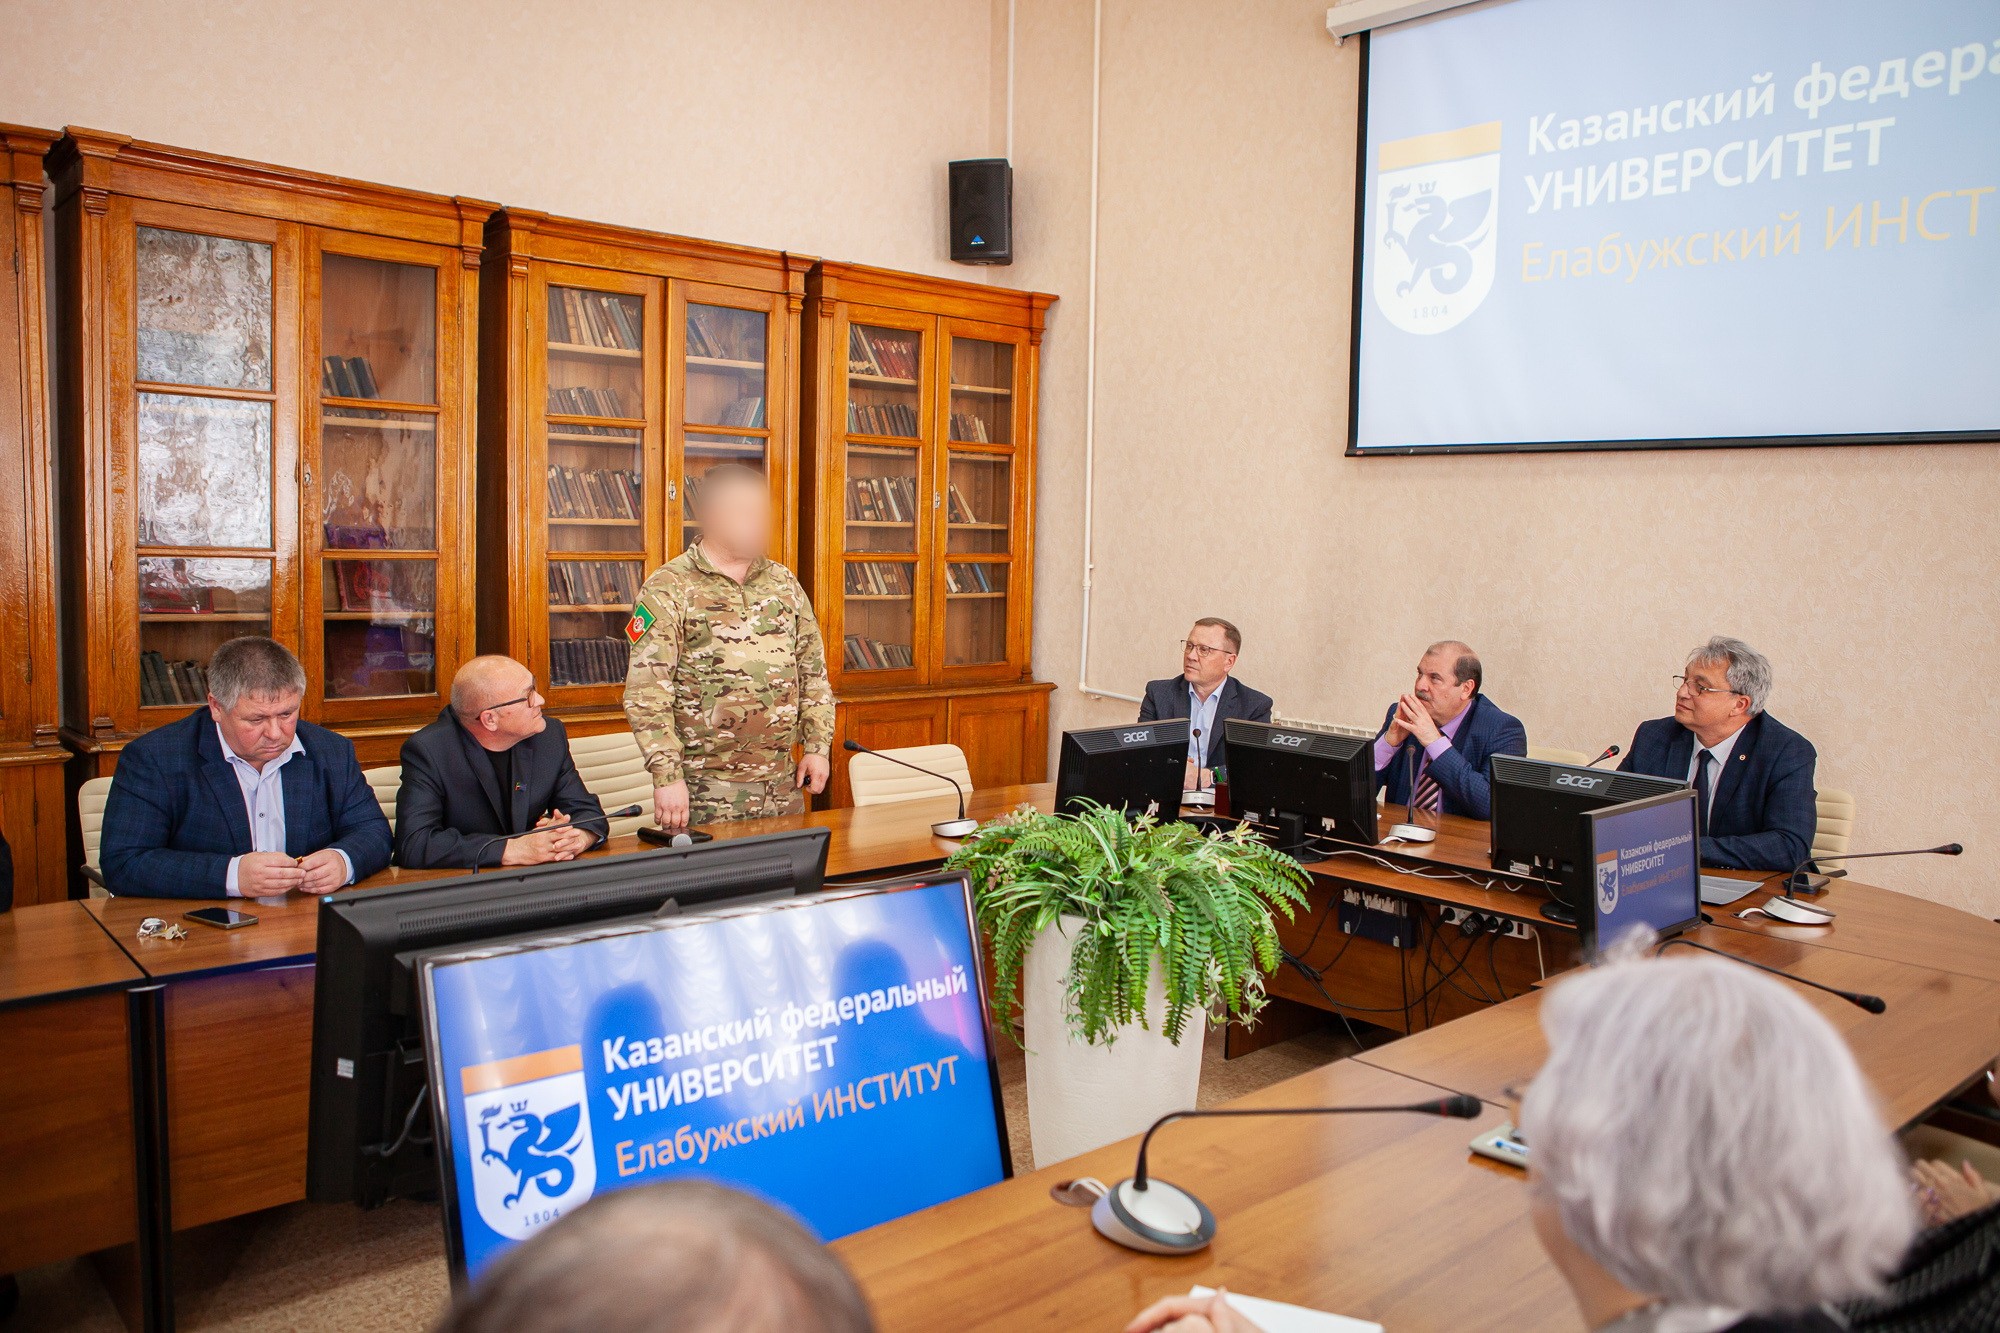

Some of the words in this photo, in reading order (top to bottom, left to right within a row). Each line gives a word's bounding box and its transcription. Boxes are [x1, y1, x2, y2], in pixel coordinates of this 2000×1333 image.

[1528, 71, 1775, 156] Казанский
[1524, 116, 1896, 214] УНИВЕРСИТЕТ
[1521, 210, 1801, 284] Елабужский
[1412, 304, 1449, 320] 1804
[1123, 730, 1150, 743] acer
[1272, 733, 1307, 748] acer
[1556, 773, 1602, 790] acer
[1620, 841, 1653, 861] Казанский
[1620, 854, 1665, 877] УНИВЕРСИТЕТ
[602, 1006, 773, 1073] Казанский
[780, 964, 968, 1036] федеральный
[606, 1035, 839, 1121] УНИВЕРСИТЕТ
[615, 1098, 805, 1178] Елабужский
[812, 1054, 960, 1123] ИНСТИТУТ
[524, 1208, 560, 1227] 1804
